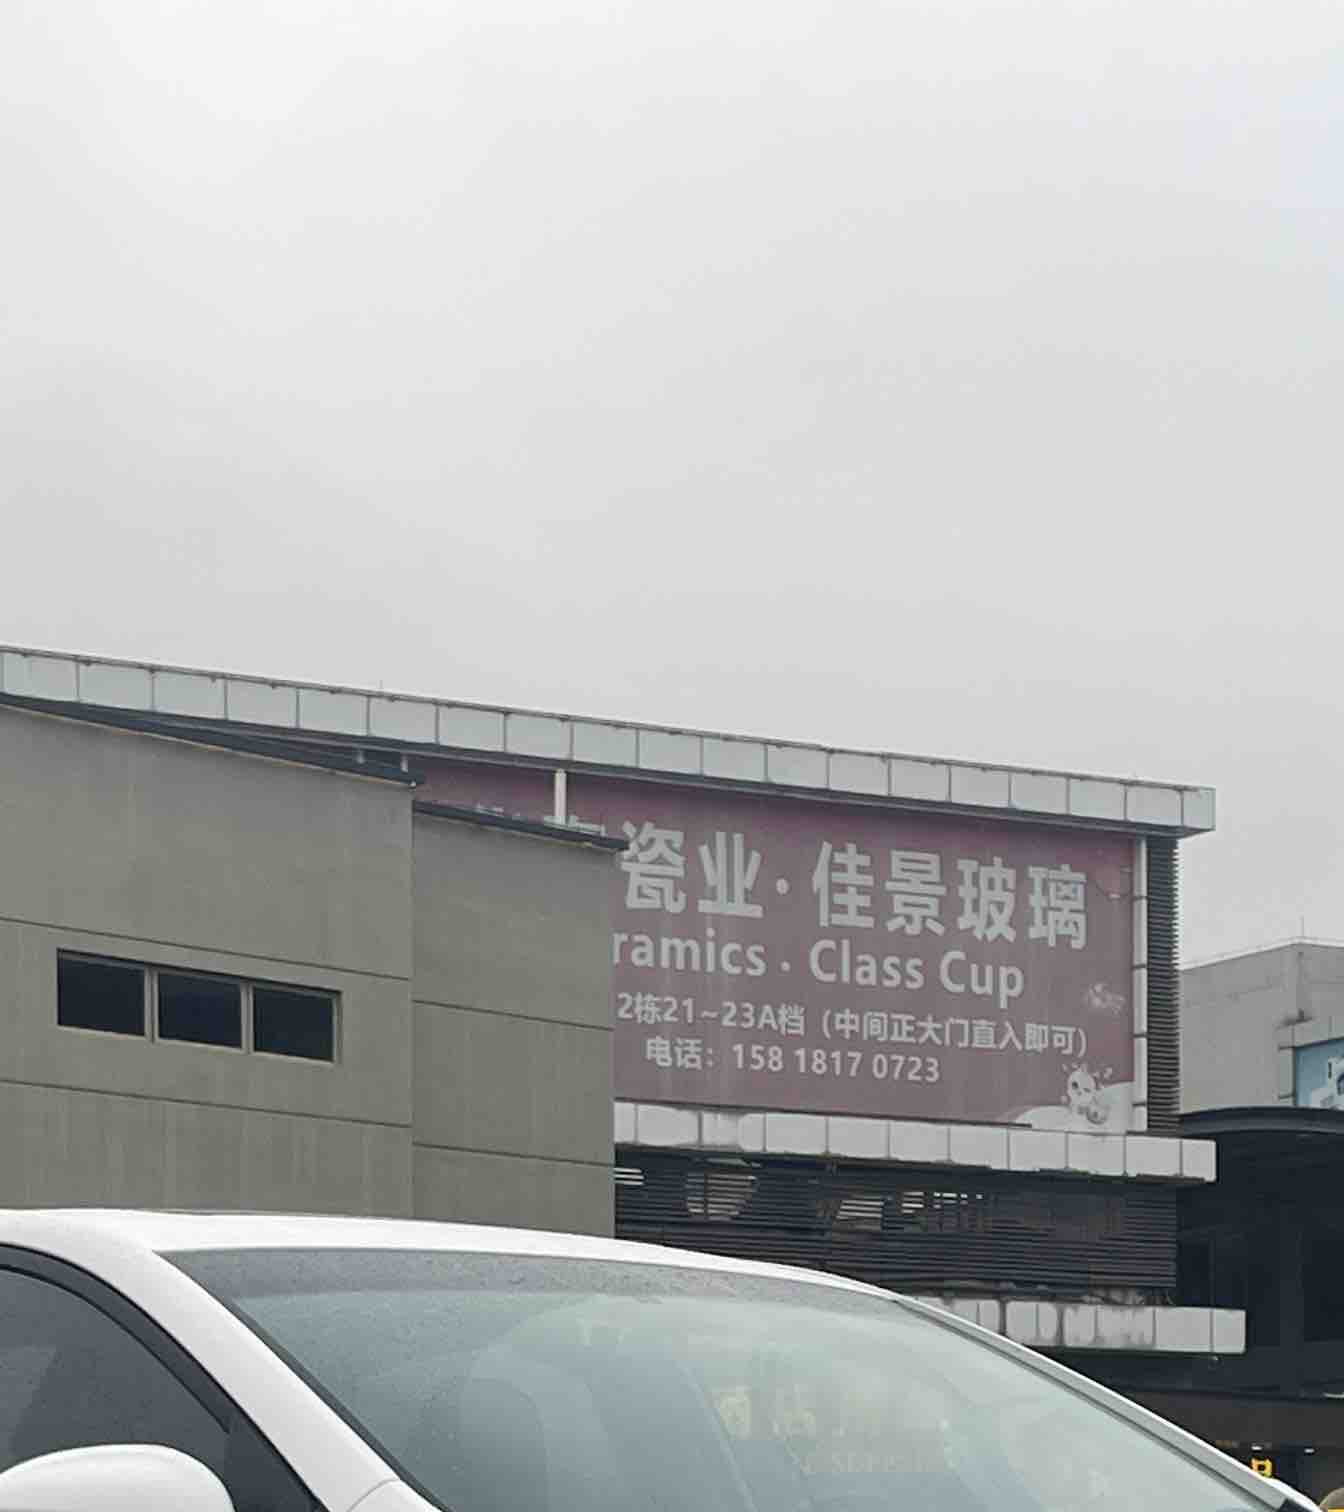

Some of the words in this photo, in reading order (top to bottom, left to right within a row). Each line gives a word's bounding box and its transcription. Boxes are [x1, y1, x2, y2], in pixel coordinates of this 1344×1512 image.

[809, 938, 925, 989] Class
[939, 950, 1026, 1009] Cup
[731, 1044, 784, 1071] 158
[794, 1047, 862, 1077] 1817
[872, 1053, 940, 1083] 0723
